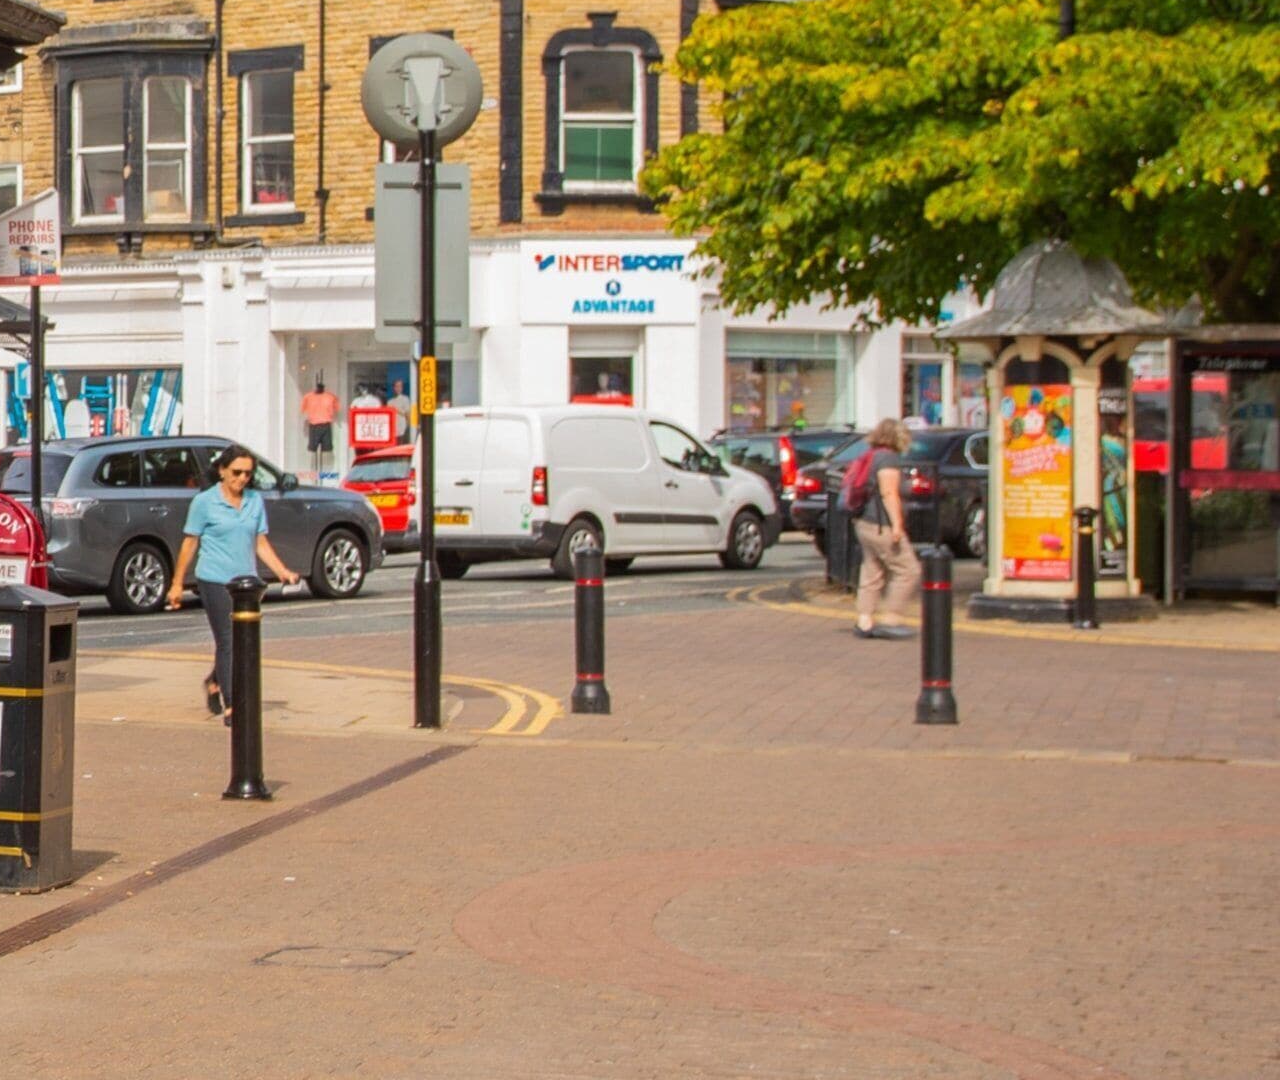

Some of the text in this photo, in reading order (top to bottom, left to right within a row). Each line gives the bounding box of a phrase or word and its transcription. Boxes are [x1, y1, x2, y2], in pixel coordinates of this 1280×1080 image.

[8, 220, 54, 234] PHONE
[8, 234, 55, 245] REPAIRS
[559, 255, 685, 271] INTERSPORT
[572, 299, 655, 313] ADVANTAGE
